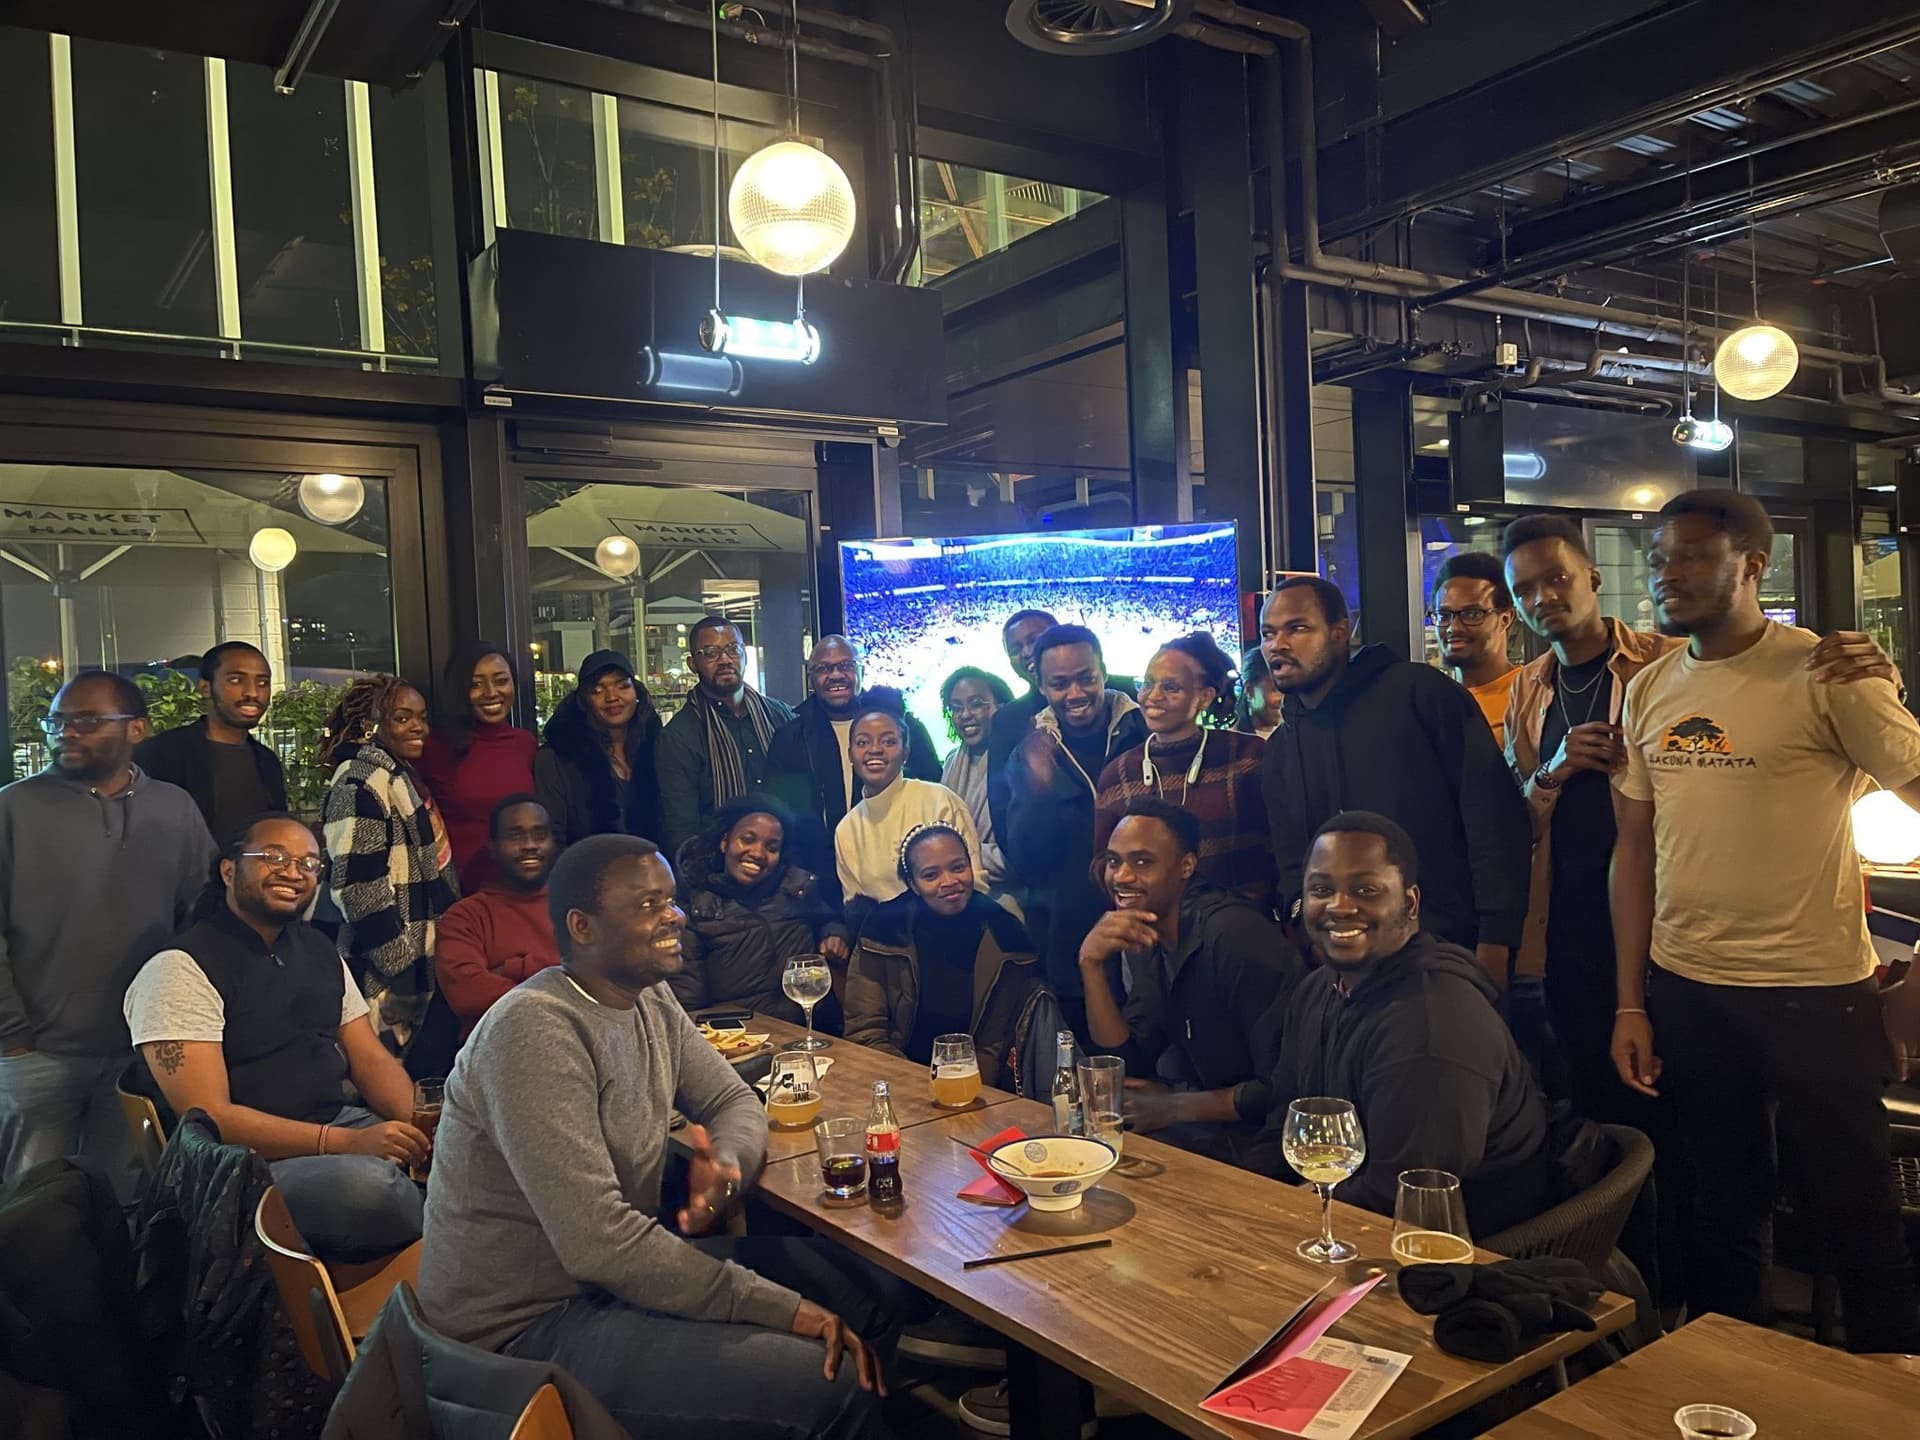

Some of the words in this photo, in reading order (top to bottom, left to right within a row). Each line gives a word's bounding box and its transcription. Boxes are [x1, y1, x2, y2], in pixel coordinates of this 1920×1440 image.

[4, 509, 161, 523] MARKET
[28, 525, 152, 536] HALLS
[633, 524, 739, 535] MARKET
[659, 536, 741, 544] HALLS
[1697, 757, 1757, 768] MATATA
